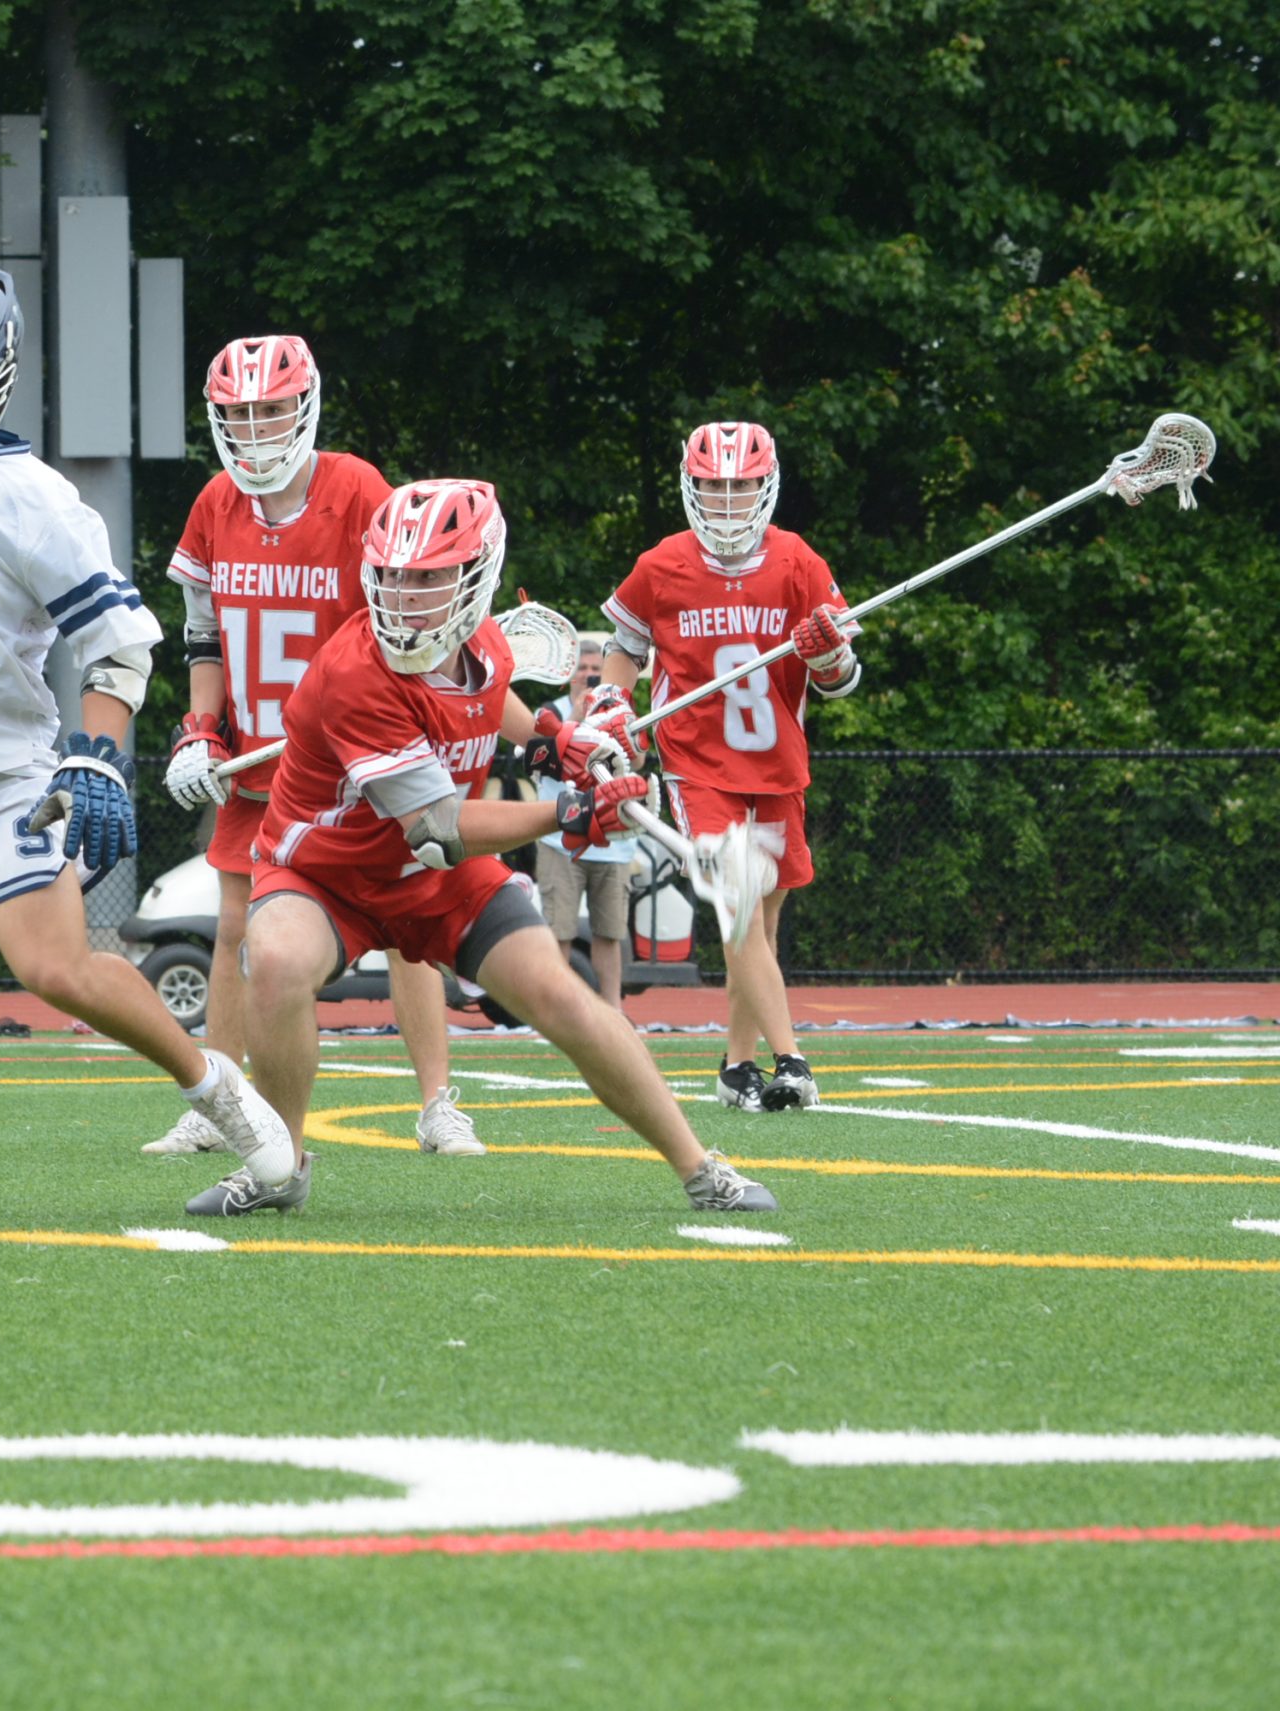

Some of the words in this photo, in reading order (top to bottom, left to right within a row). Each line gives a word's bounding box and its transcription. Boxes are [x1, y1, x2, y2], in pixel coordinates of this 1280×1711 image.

[211, 561, 340, 600] GREENWICH
[220, 606, 317, 738] 15
[713, 643, 778, 752] 8
[13, 814, 55, 860] S
